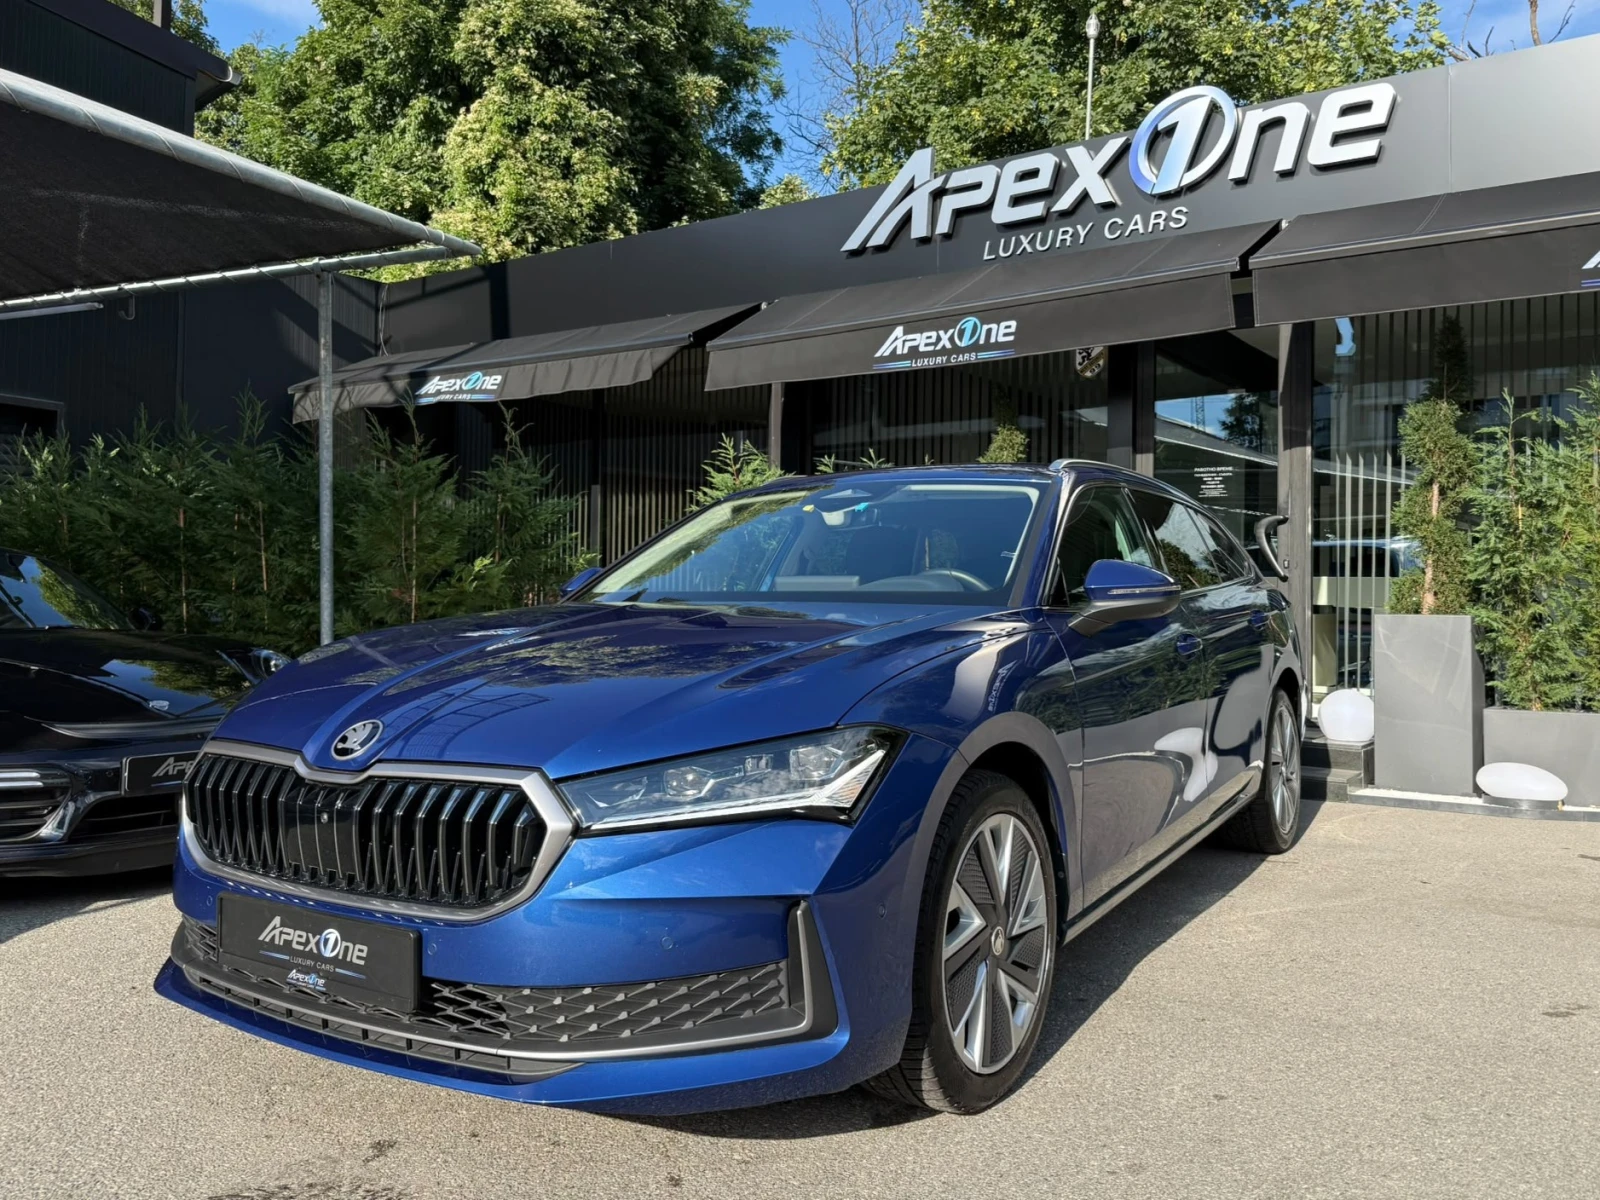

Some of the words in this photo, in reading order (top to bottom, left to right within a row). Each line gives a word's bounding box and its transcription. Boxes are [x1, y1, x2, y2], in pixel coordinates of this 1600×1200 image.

[983, 222, 1093, 261] LUXURY
[1103, 206, 1189, 241] CARS
[911, 355, 947, 367] LUXURY
[950, 352, 976, 363] CARS
[290, 955, 315, 967] LUXURY
[316, 962, 334, 972] CARS
